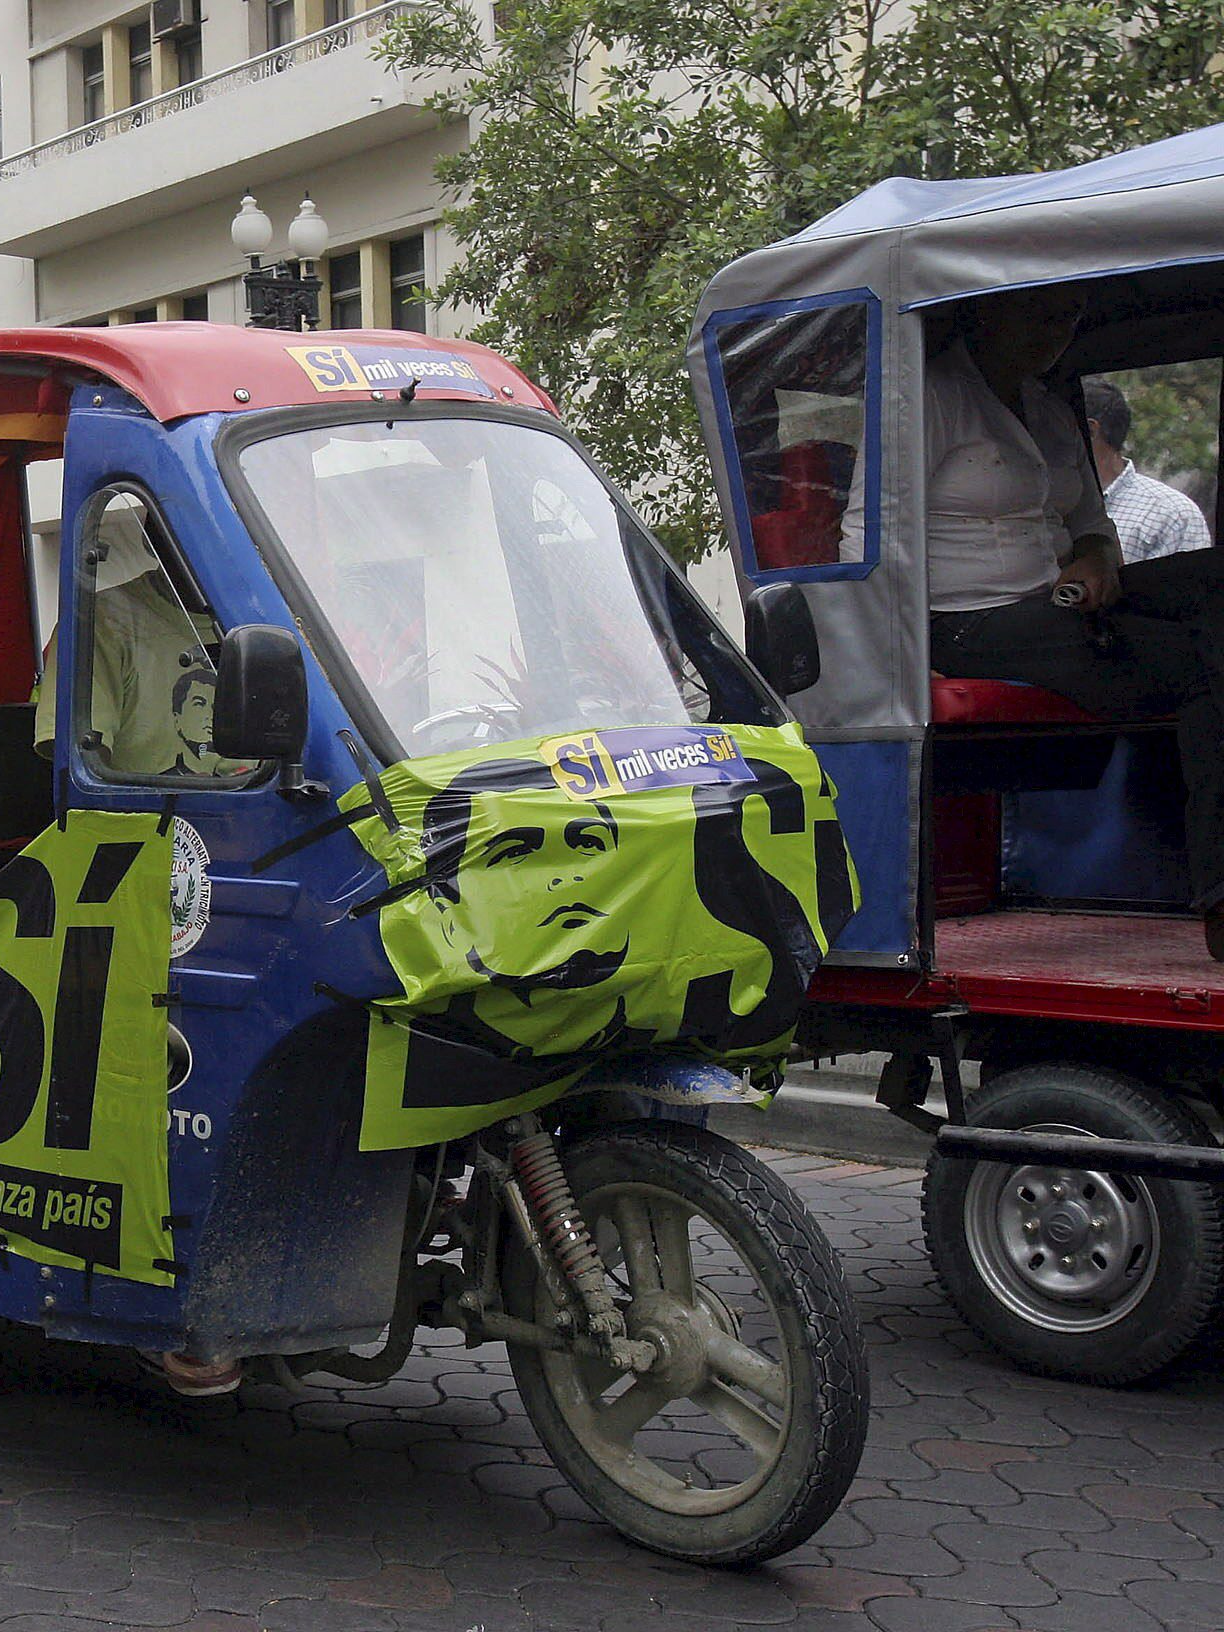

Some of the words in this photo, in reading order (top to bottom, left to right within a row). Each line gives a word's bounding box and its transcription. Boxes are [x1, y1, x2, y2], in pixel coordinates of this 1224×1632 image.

[362, 359, 397, 382] mil
[396, 361, 455, 377] veces
[615, 749, 653, 781] mil
[650, 743, 709, 772] veces
[41, 1184, 113, 1231] país
